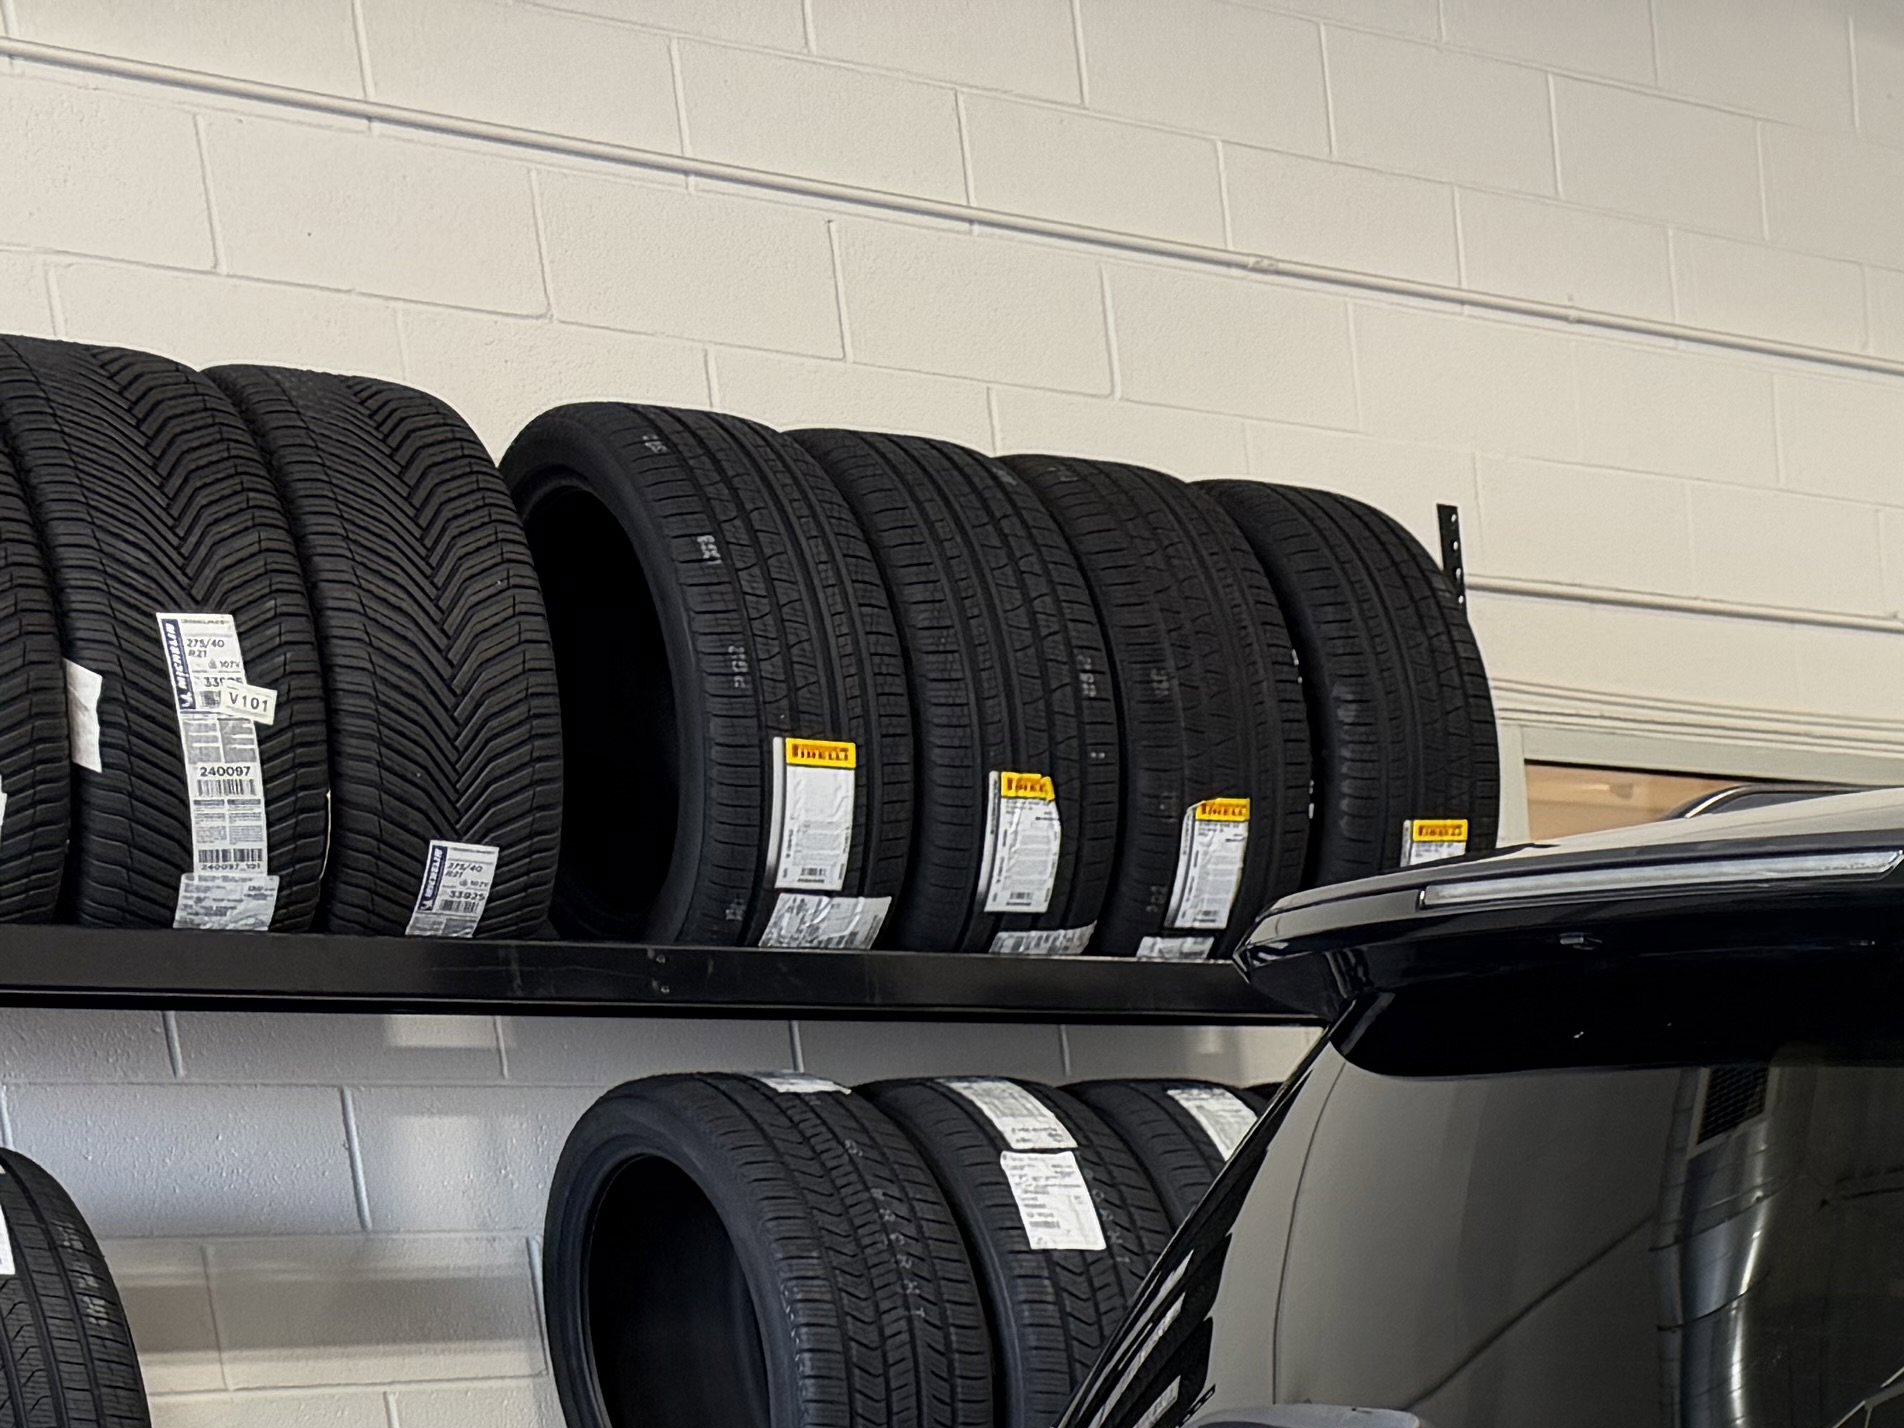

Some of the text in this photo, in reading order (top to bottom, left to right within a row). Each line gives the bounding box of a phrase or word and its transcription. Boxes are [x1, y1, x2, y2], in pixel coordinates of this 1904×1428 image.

[187, 638, 225, 649] 275/40
[165, 622, 189, 690] MICHELIN
[229, 692, 269, 713] V101
[199, 766, 251, 777] 240097
